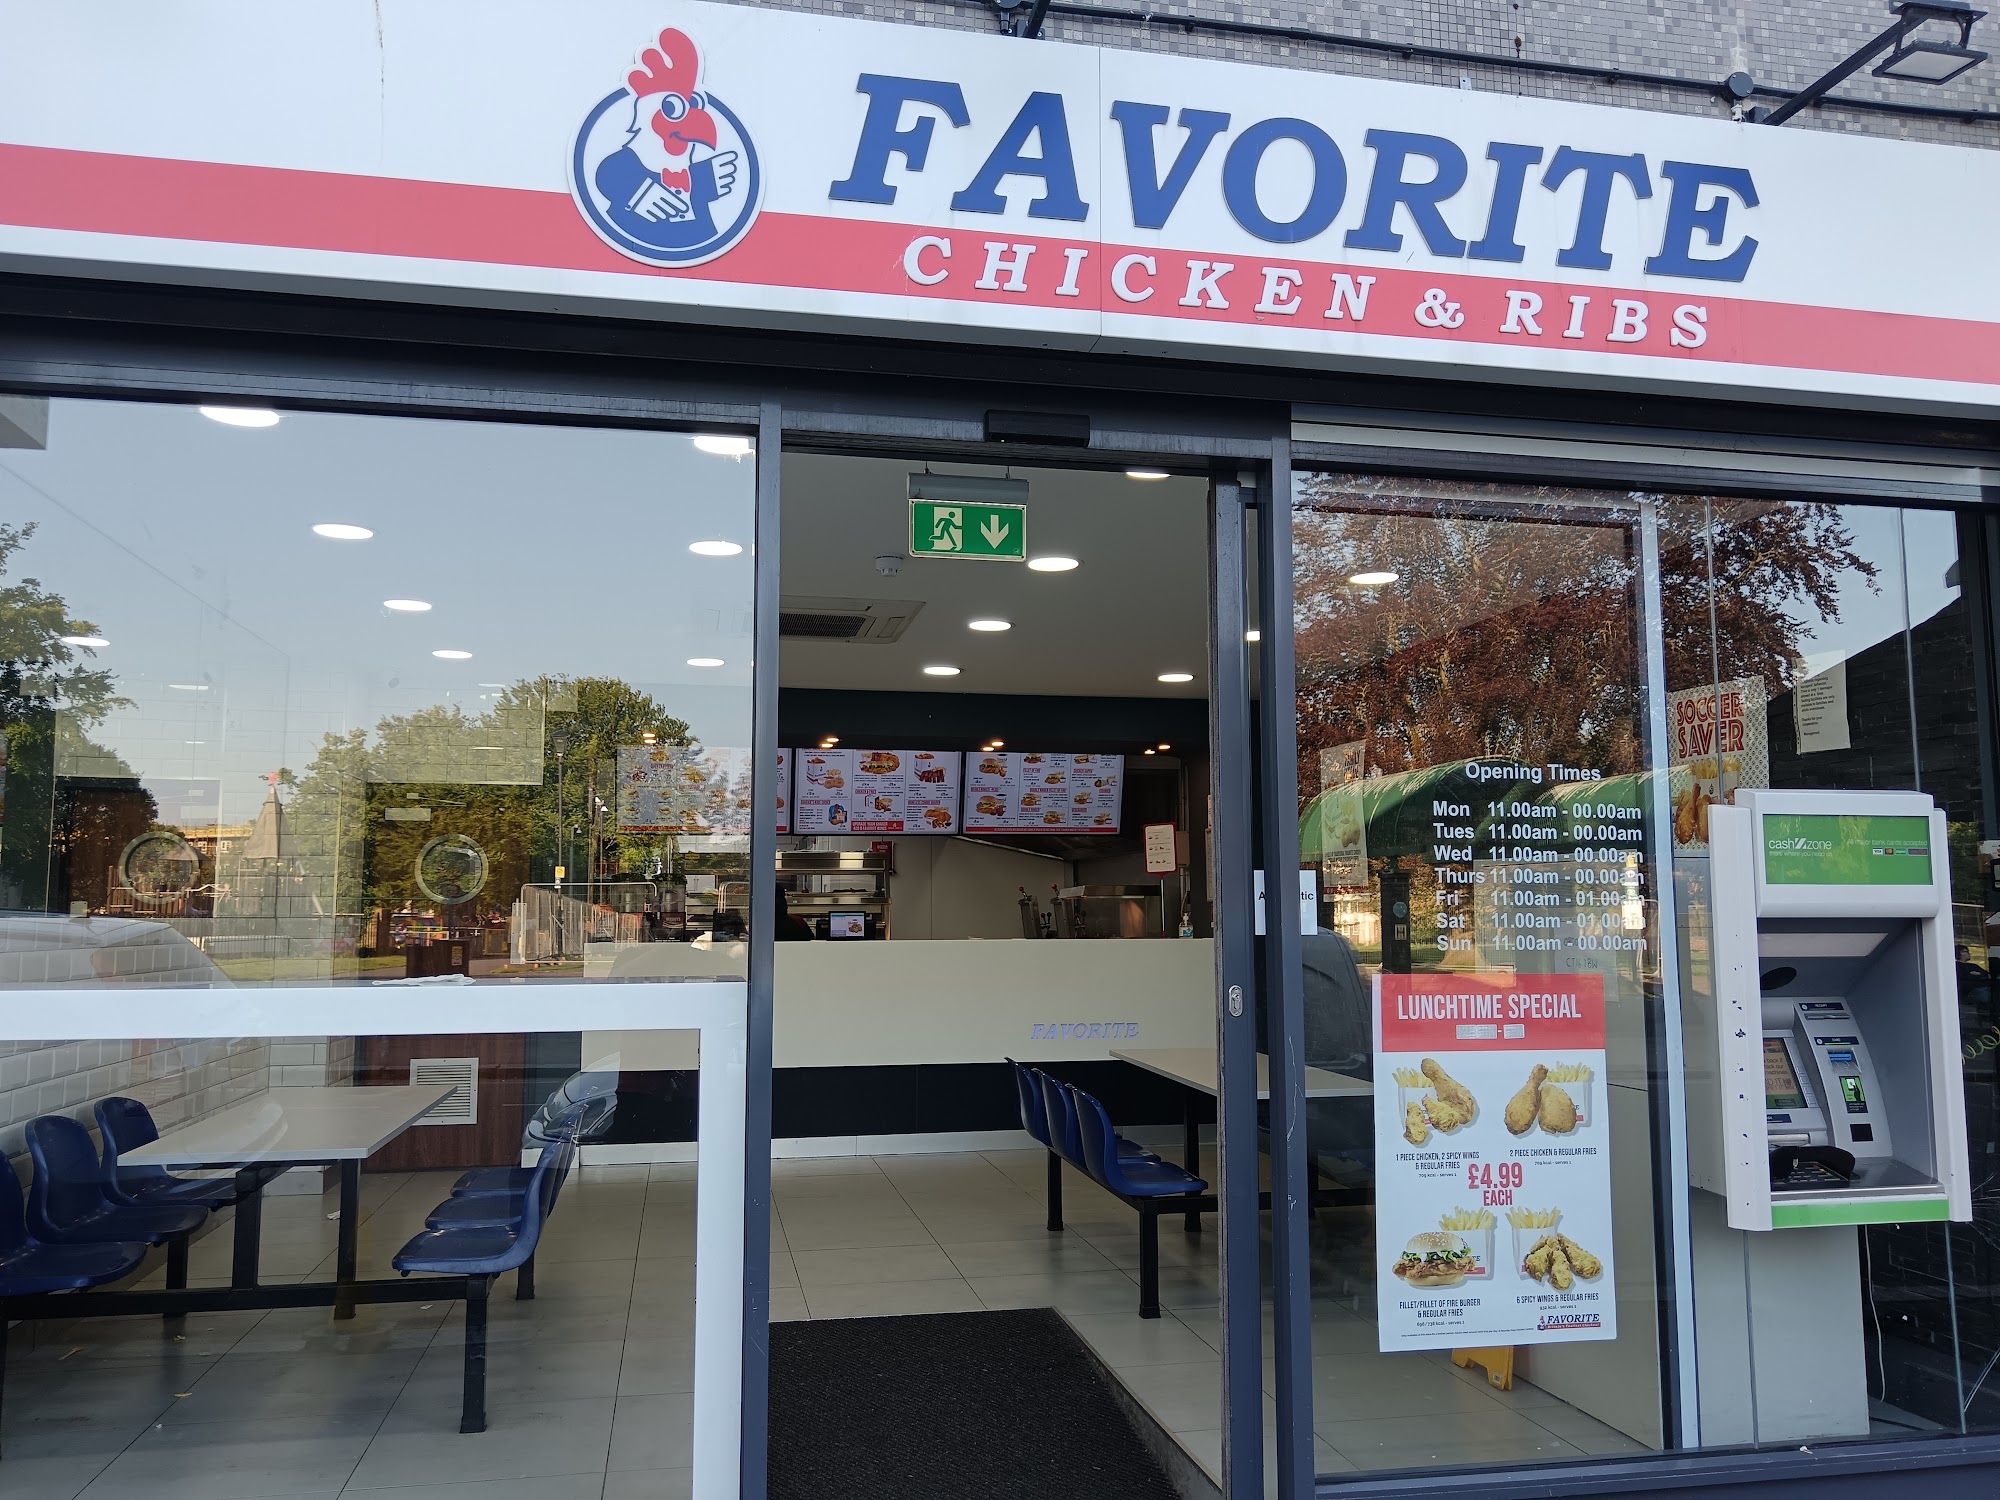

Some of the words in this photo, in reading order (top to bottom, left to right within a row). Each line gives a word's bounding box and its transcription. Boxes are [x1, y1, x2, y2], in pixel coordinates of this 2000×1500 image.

[828, 72, 1762, 281] FAVORITE
[902, 235, 1377, 322] CHICKEN
[1413, 287, 1465, 330] &
[1498, 289, 1709, 349] RIBS
[1676, 692, 1744, 726] SOCCER
[1677, 719, 1744, 759] SAVER
[1465, 762, 1541, 784] Opening
[1547, 764, 1601, 781] Times
[1433, 801, 1470, 817] Mon
[1488, 802, 1557, 817] 11.00am
[1572, 803, 1642, 819] 00.00am
[1432, 823, 1475, 839] Tues
[1488, 824, 1558, 839] 11.00am
[1573, 825, 1643, 840] 00.00am
[1433, 844, 1472, 861] Wed
[1489, 846, 1558, 862] 11.00am
[1574, 848, 1644, 863] 00.00am
[1434, 868, 1485, 884] Thurs
[1490, 868, 1559, 884] 11.00am
[1575, 869, 1644, 884] 00.00am
[1436, 890, 1459, 906] Fri
[1490, 890, 1560, 906] 11.00am
[1436, 912, 1465, 928] Sat
[1492, 912, 1561, 928] 11.00am
[1437, 934, 1471, 951] Sun
[1492, 934, 1562, 950] 11.00am
[1578, 935, 1648, 950] 00.00am
[1397, 994, 1503, 1021] LUNCHTIME
[1508, 993, 1582, 1020] SPECIAL
[1031, 1022, 1140, 1041] FAVORITE
[1400, 1153, 1415, 1161] PIECE
[1416, 1152, 1440, 1161] CHICKEN,
[1463, 1151, 1480, 1159] WINGS
[1554, 1148, 1557, 1156] &
[1559, 1148, 1581, 1156] REGULAR
[1583, 1147, 1596, 1155] FRIES
[1415, 1162, 1419, 1170] &
[1420, 1162, 1444, 1170] REGULAR
[1446, 1161, 1460, 1169] FRIES
[1468, 1162, 1522, 1189] £4.99
[1484, 1190, 1512, 1206] EACH
[1400, 1300, 1437, 1309] FILLET/FILLET
[1447, 1299, 1458, 1307] FIRE
[1517, 1296, 1520, 1304] 6
[1537, 1294, 1554, 1302] WINGS
[1560, 1293, 1583, 1302] REGULAR
[1418, 1310, 1422, 1318] &
[1423, 1309, 1446, 1317] REGULAR
[1547, 1314, 1600, 1324] FAVORITE
